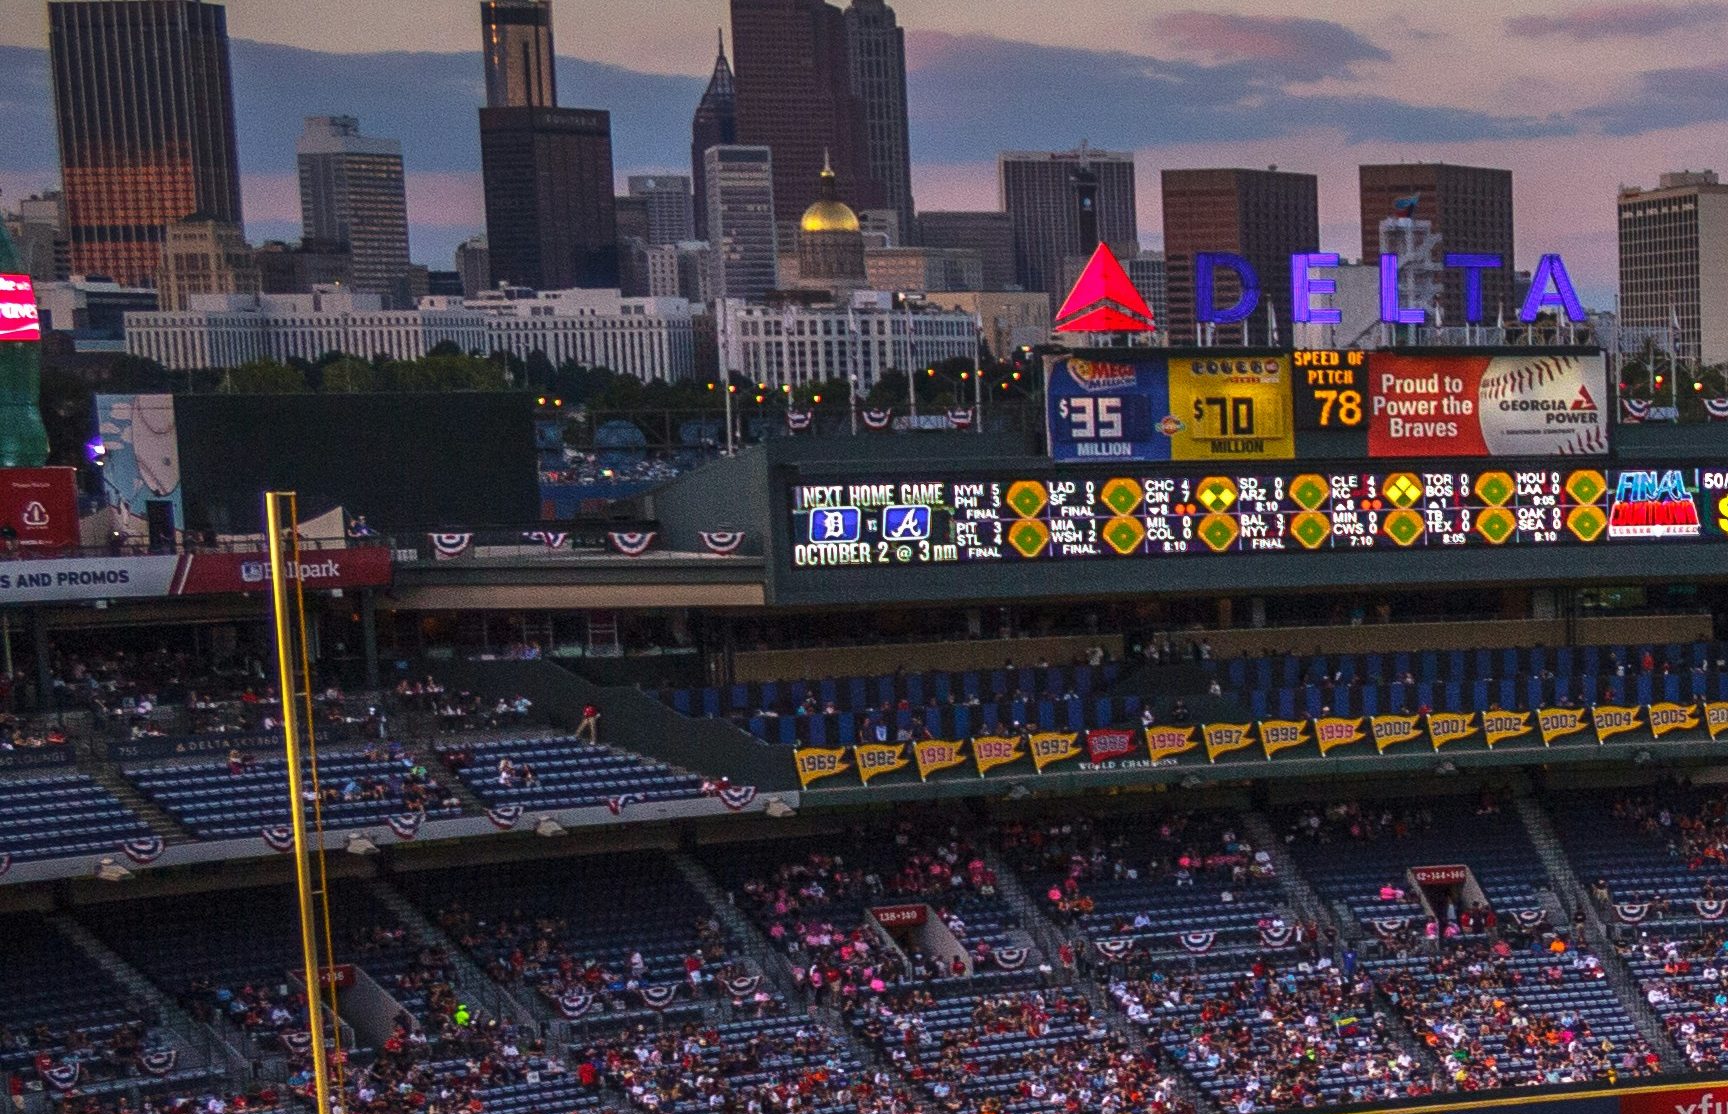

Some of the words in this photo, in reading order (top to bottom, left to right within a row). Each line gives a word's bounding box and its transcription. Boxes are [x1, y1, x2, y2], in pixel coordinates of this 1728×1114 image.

[1195, 252, 1588, 324] DELTA
[1294, 352, 1339, 366] SPEED
[1347, 351, 1364, 366] OF
[1308, 370, 1353, 384] PITCH
[1382, 373, 1439, 395] Proud
[1444, 376, 1462, 392] to
[1314, 390, 1363, 426] 78
[1374, 398, 1436, 416] Power
[1442, 396, 1473, 413] the
[1500, 399, 1566, 411] GEORGIA
[1059, 397, 1122, 438] $35
[1194, 397, 1253, 436] $70
[1546, 413, 1598, 424] POWER
[1390, 418, 1458, 437] Braves
[1078, 443, 1131, 456] MILLION
[1211, 440, 1264, 453] MILLION
[803, 486, 843, 507] NEXT
[850, 485, 894, 507] HOME
[901, 484, 944, 505] GAME
[955, 485, 983, 497] NYM
[992, 483, 999, 495] 5
[1050, 482, 1075, 494] LAD
[1086, 481, 1094, 492] 0
[967, 509, 999, 519] FINAL
[1061, 506, 1095, 516] FINAL
[795, 544, 871, 566] OCTOBER
[878, 542, 889, 563] 2
[919, 542, 930, 561] 3
[16, 573, 52, 589] AND
[57, 569, 129, 586] PROMOS
[264, 559, 340, 581] Bllpark
[1432, 716, 1468, 734] 2001
[1595, 710, 1632, 729] 2004
[1651, 707, 1687, 725] 2005
[1207, 729, 1244, 747] 1997
[1263, 726, 1299, 743] 1998
[1375, 720, 1411, 738] 2000
[1034, 738, 1069, 756] 1993
[1150, 733, 1185, 751] 1996
[800, 754, 838, 772] 1969
[860, 750, 897, 767] 1982
